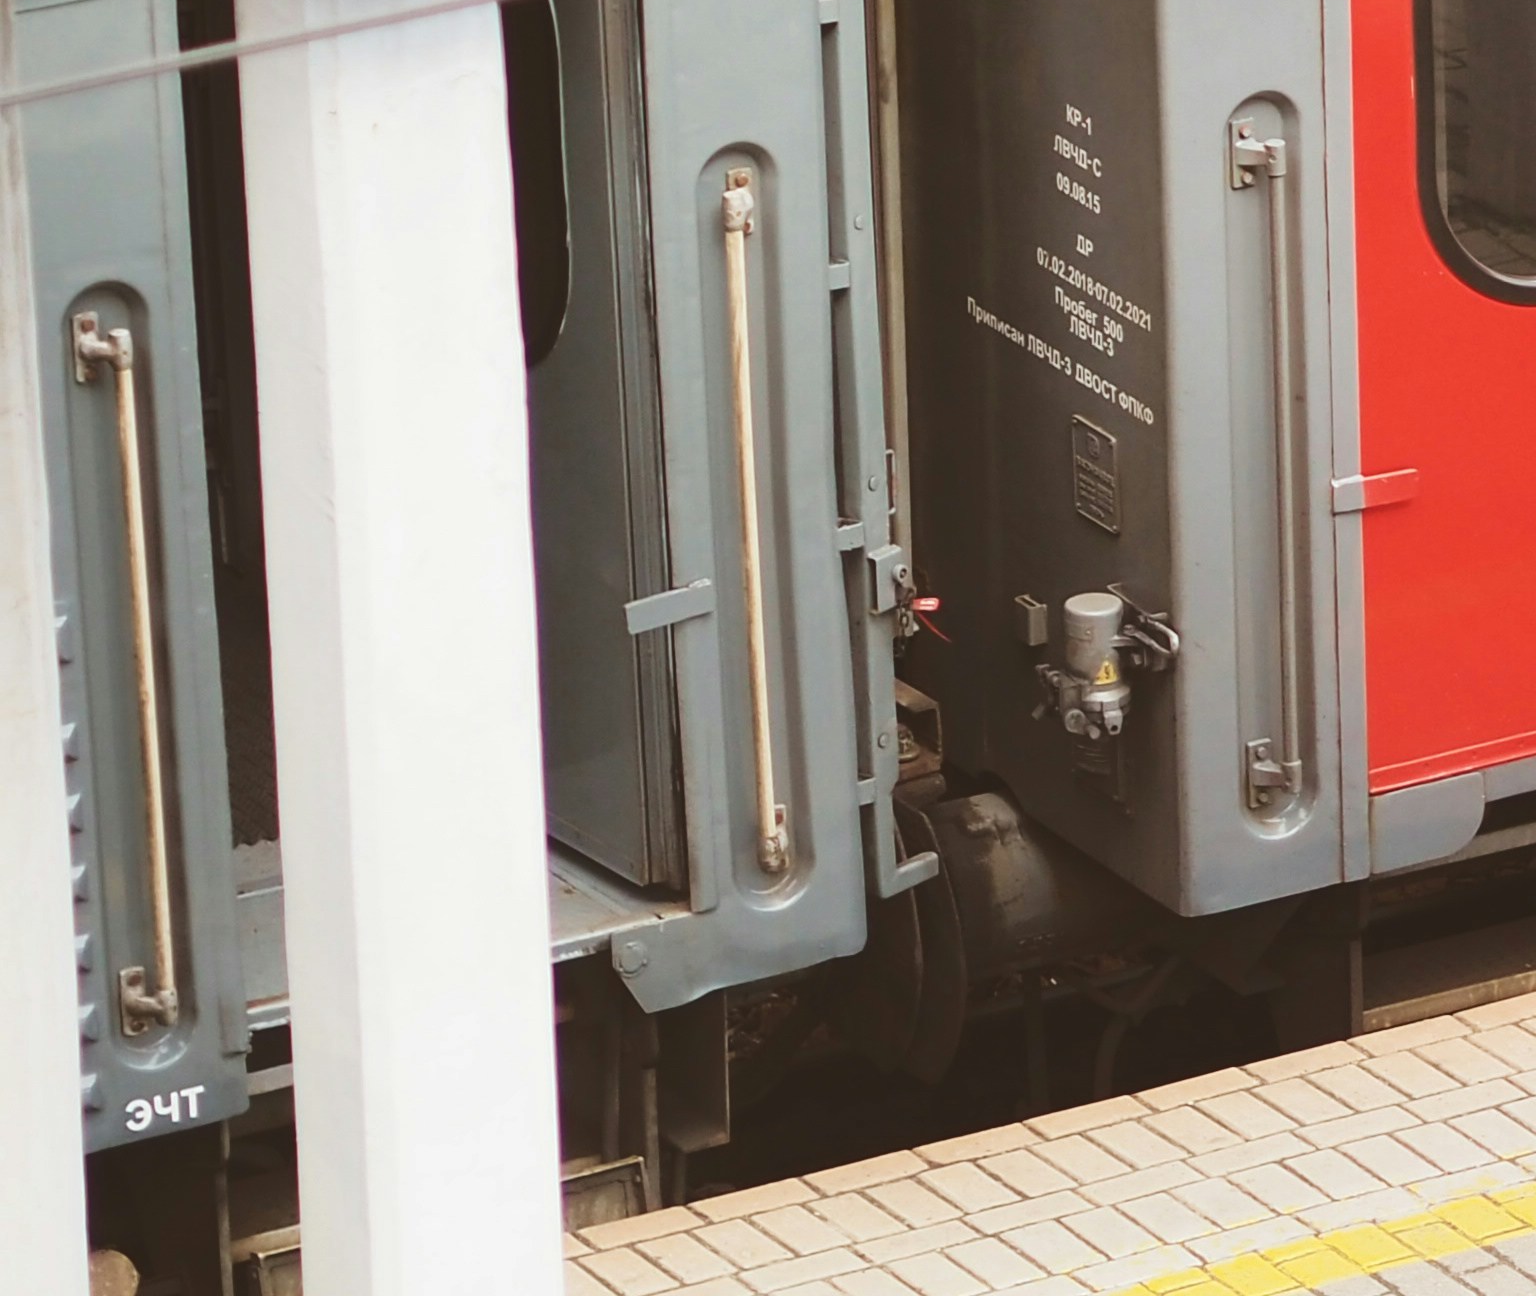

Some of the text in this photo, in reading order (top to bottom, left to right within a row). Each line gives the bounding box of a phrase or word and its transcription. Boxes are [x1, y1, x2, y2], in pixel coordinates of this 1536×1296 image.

[1066, 103, 1092, 136] КР-1
[1056, 172, 1101, 214] 09.08.15
[1076, 234, 1094, 257] ДР
[1055, 285, 1124, 343] Пробег 500
[967, 295, 1025, 348] Приписан
[1075, 362, 1117, 404] ДВОСТ
[1118, 391, 1154, 425] ФПКФ
[125, 1085, 205, 1132] ЭЧТ
